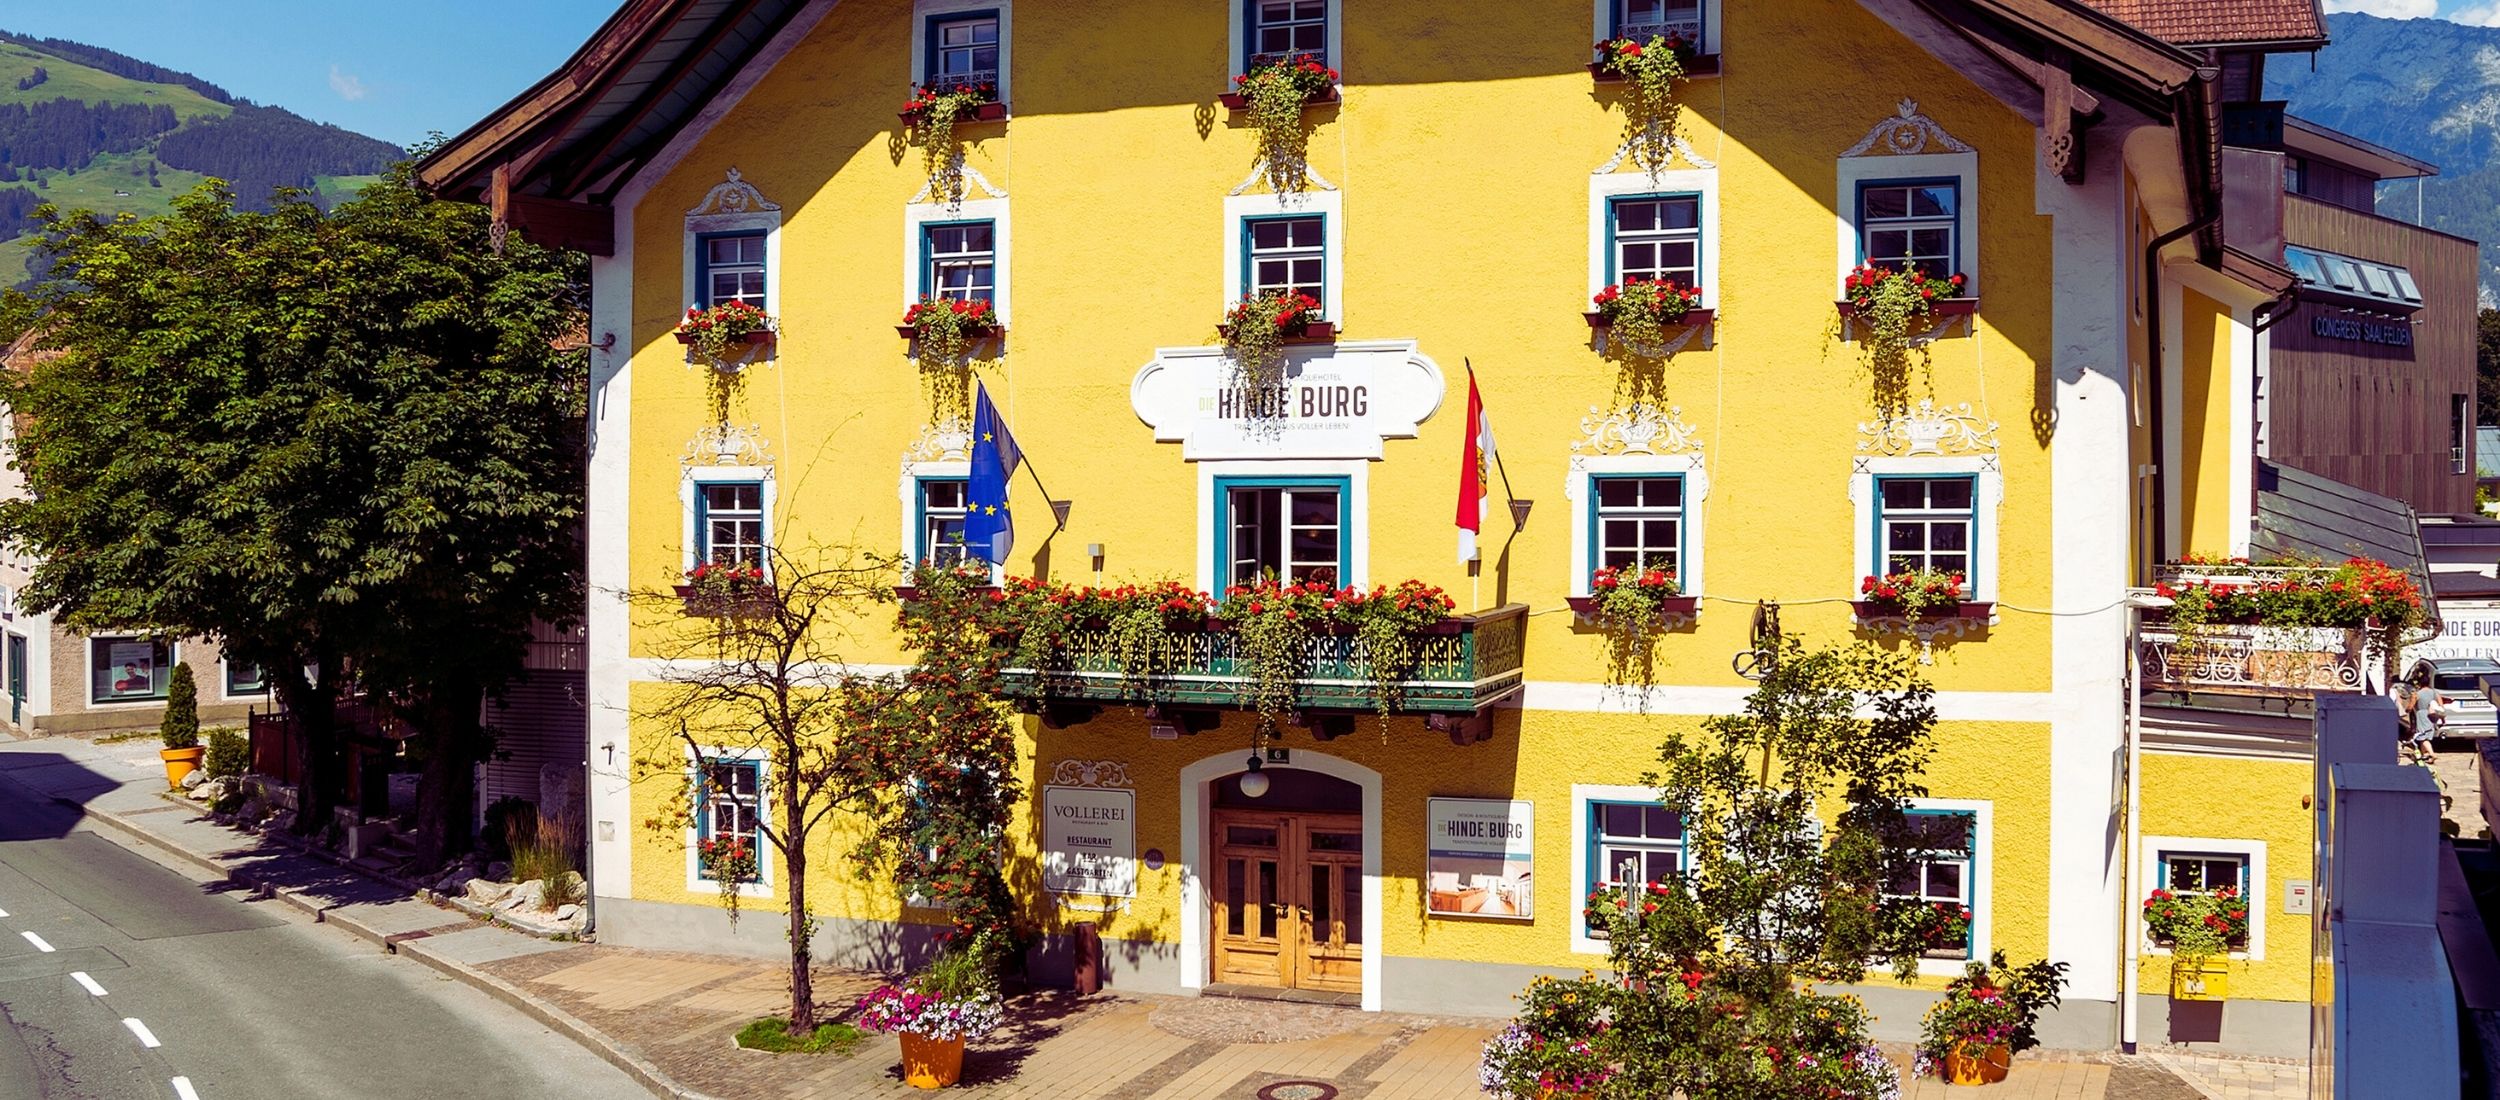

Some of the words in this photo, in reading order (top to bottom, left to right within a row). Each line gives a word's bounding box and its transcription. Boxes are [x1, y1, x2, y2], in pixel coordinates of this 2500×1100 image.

[2315, 316, 2361, 340] CONGRESS
[2364, 323, 2411, 346] SAALFELDEN
[1199, 396, 1215, 411] DIE
[1274, 750, 1282, 760] 6
[1054, 805, 1125, 820] VOLLEREI
[1066, 835, 1112, 846] RESTAURANT
[1066, 867, 1113, 878] GASTGARTEN
